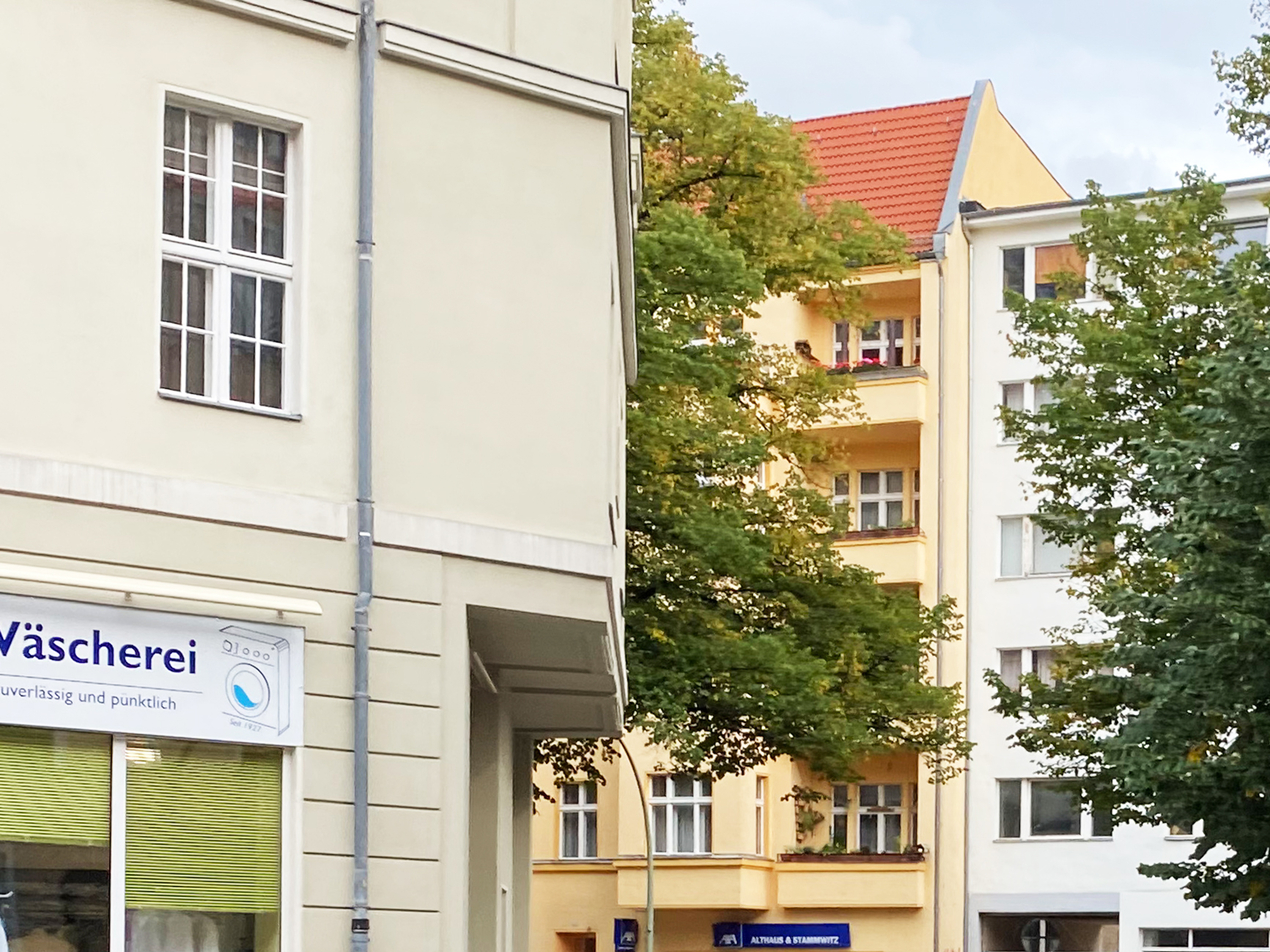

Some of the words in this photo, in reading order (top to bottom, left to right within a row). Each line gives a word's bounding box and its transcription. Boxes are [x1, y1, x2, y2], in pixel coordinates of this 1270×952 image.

[0, 685, 73, 706] uverlässig
[78, 691, 105, 704] und
[111, 692, 177, 710] pünktlich
[750, 936, 784, 944] ALTHAUS
[784, 936, 792, 944] &
